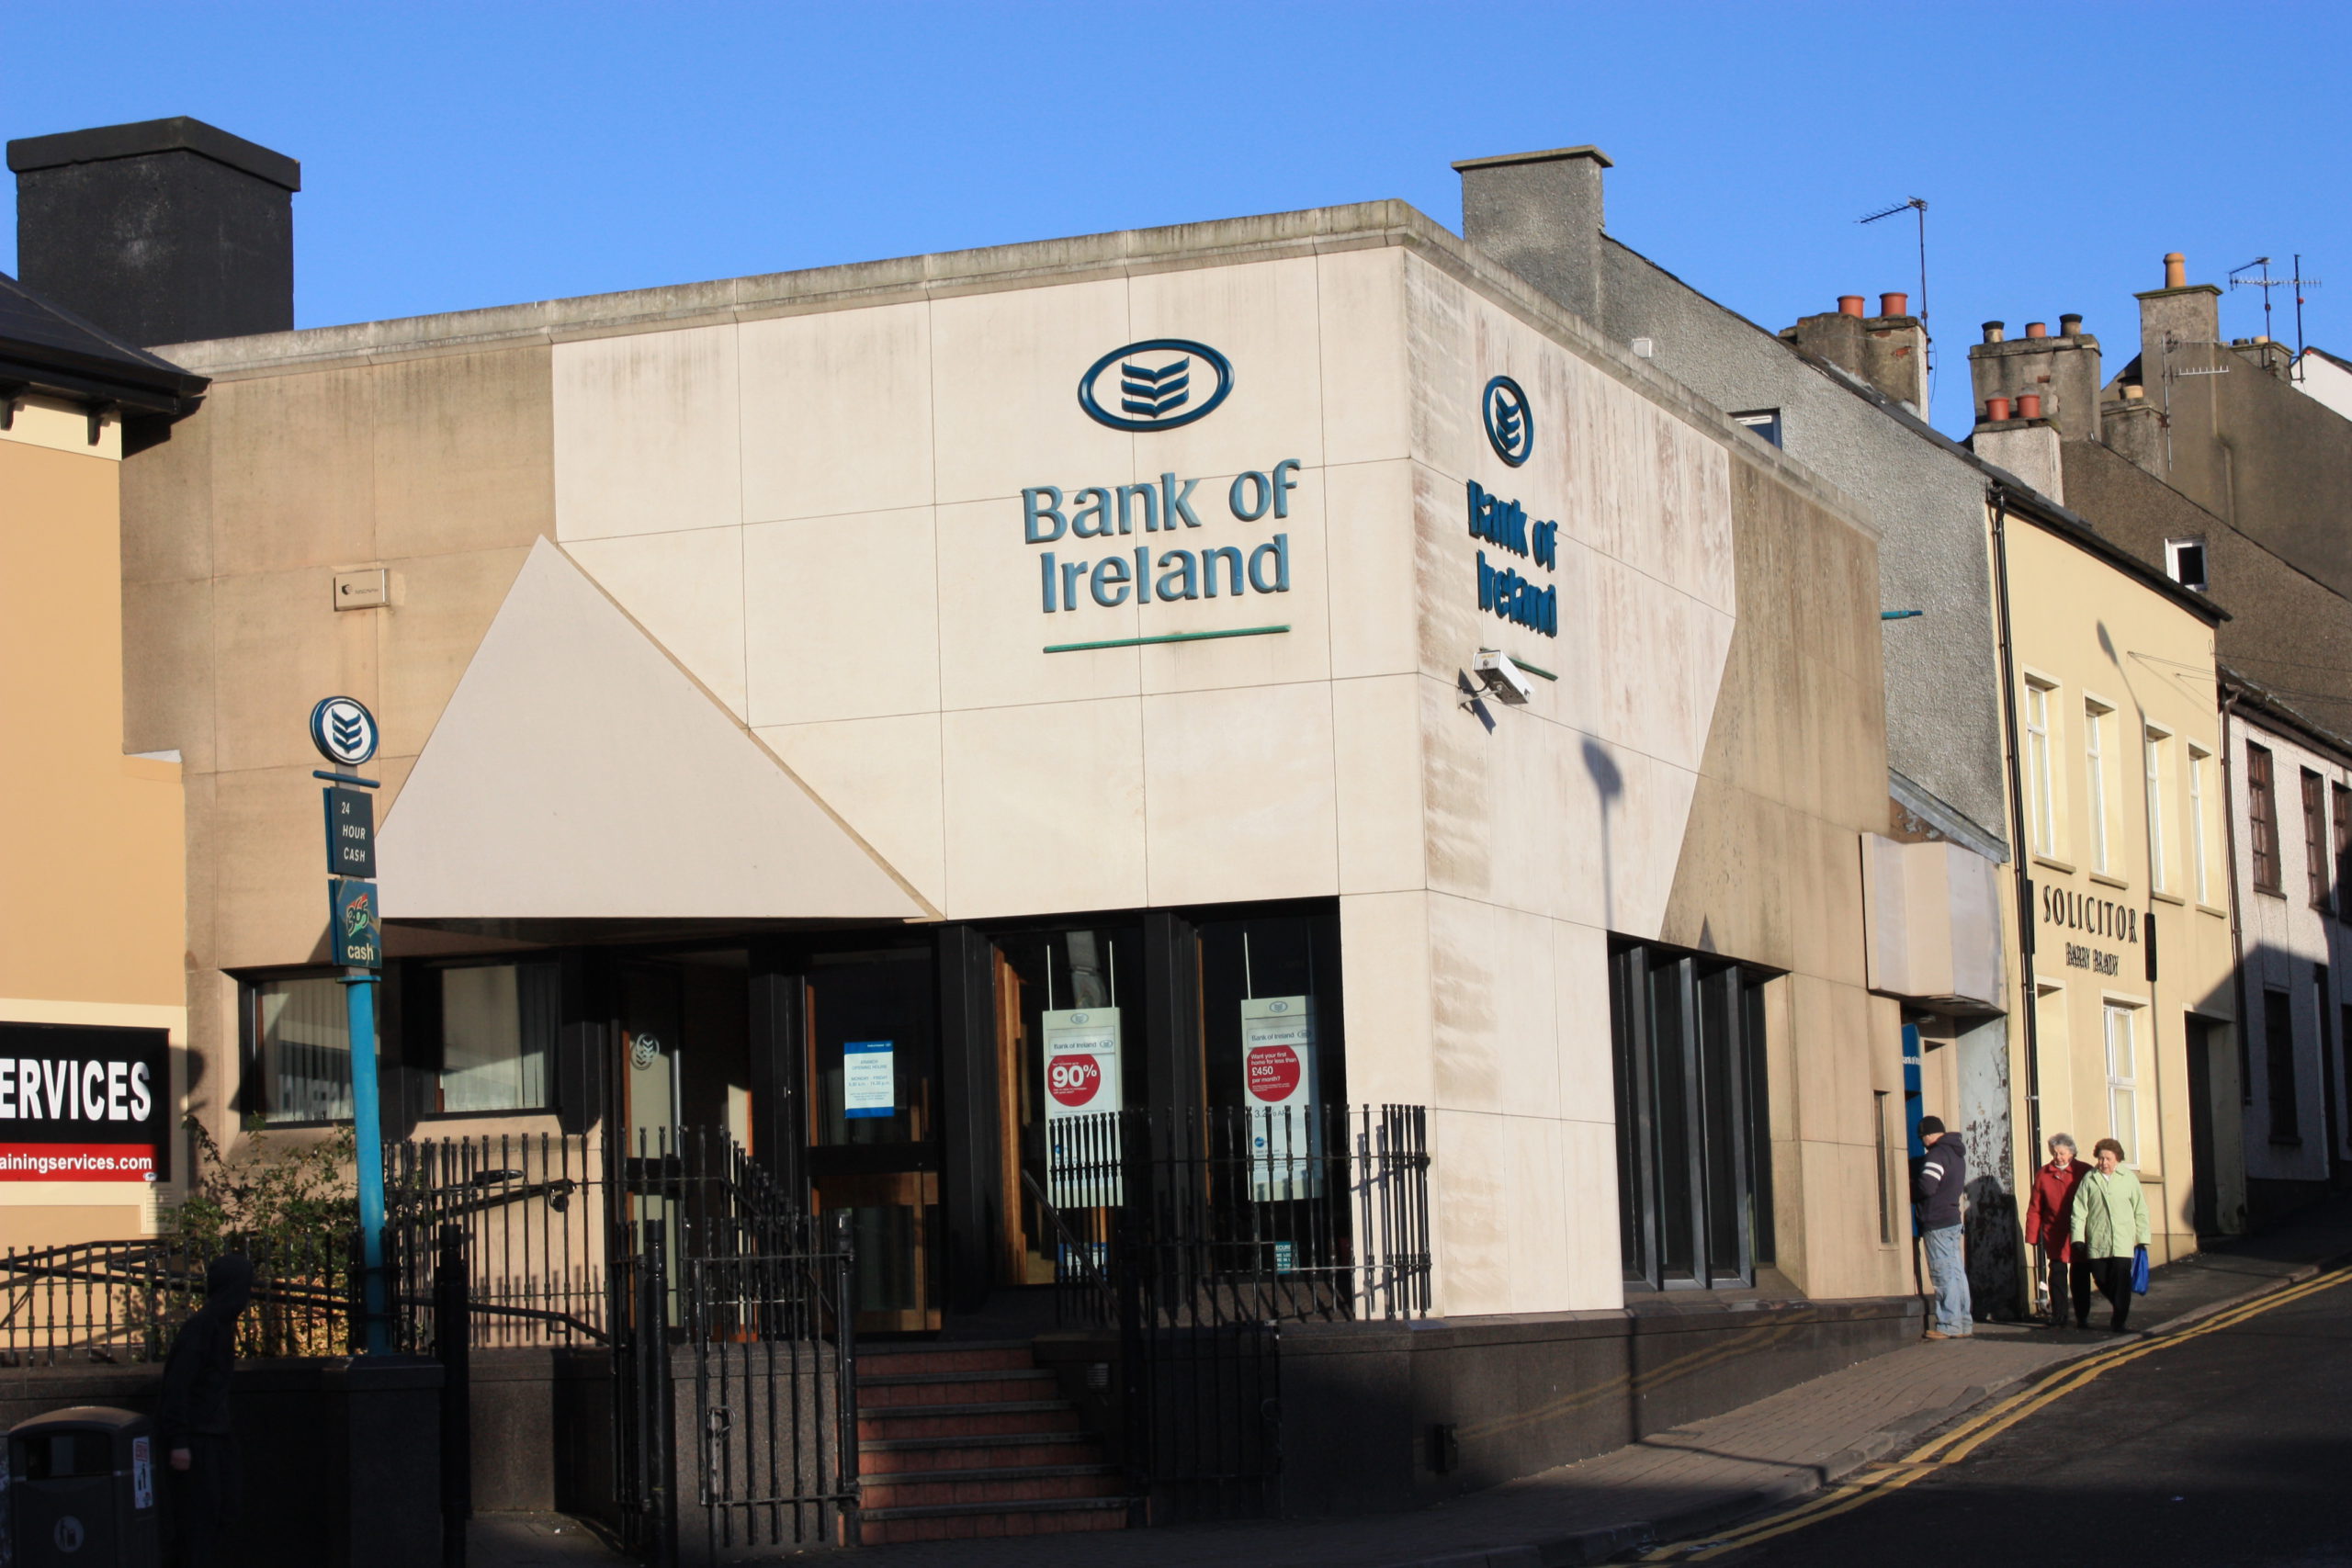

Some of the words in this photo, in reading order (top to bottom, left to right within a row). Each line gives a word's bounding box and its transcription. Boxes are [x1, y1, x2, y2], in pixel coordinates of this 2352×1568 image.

[1021, 472, 1202, 545] Bank
[1228, 458, 1301, 522] of
[1466, 479, 1529, 559] Bank
[1532, 520, 1558, 573] of
[1040, 533, 1290, 614] Ireland
[1476, 549, 1557, 638] Ireland
[341, 802, 350, 815] 24
[343, 824, 366, 840] HOUR
[344, 847, 366, 863] CASH
[346, 895, 369, 937] 365
[2042, 885, 2138, 944] SOLICITOR
[347, 942, 374, 962] cash
[2065, 942, 2090, 970] BARRY
[2093, 948, 2119, 977] BRADY
[1052, 1065, 1097, 1089] 90%
[1252, 1066, 1273, 1077] £450
[0, 1058, 151, 1122] ERVICES
[0, 1154, 152, 1174] ainingservices.com
